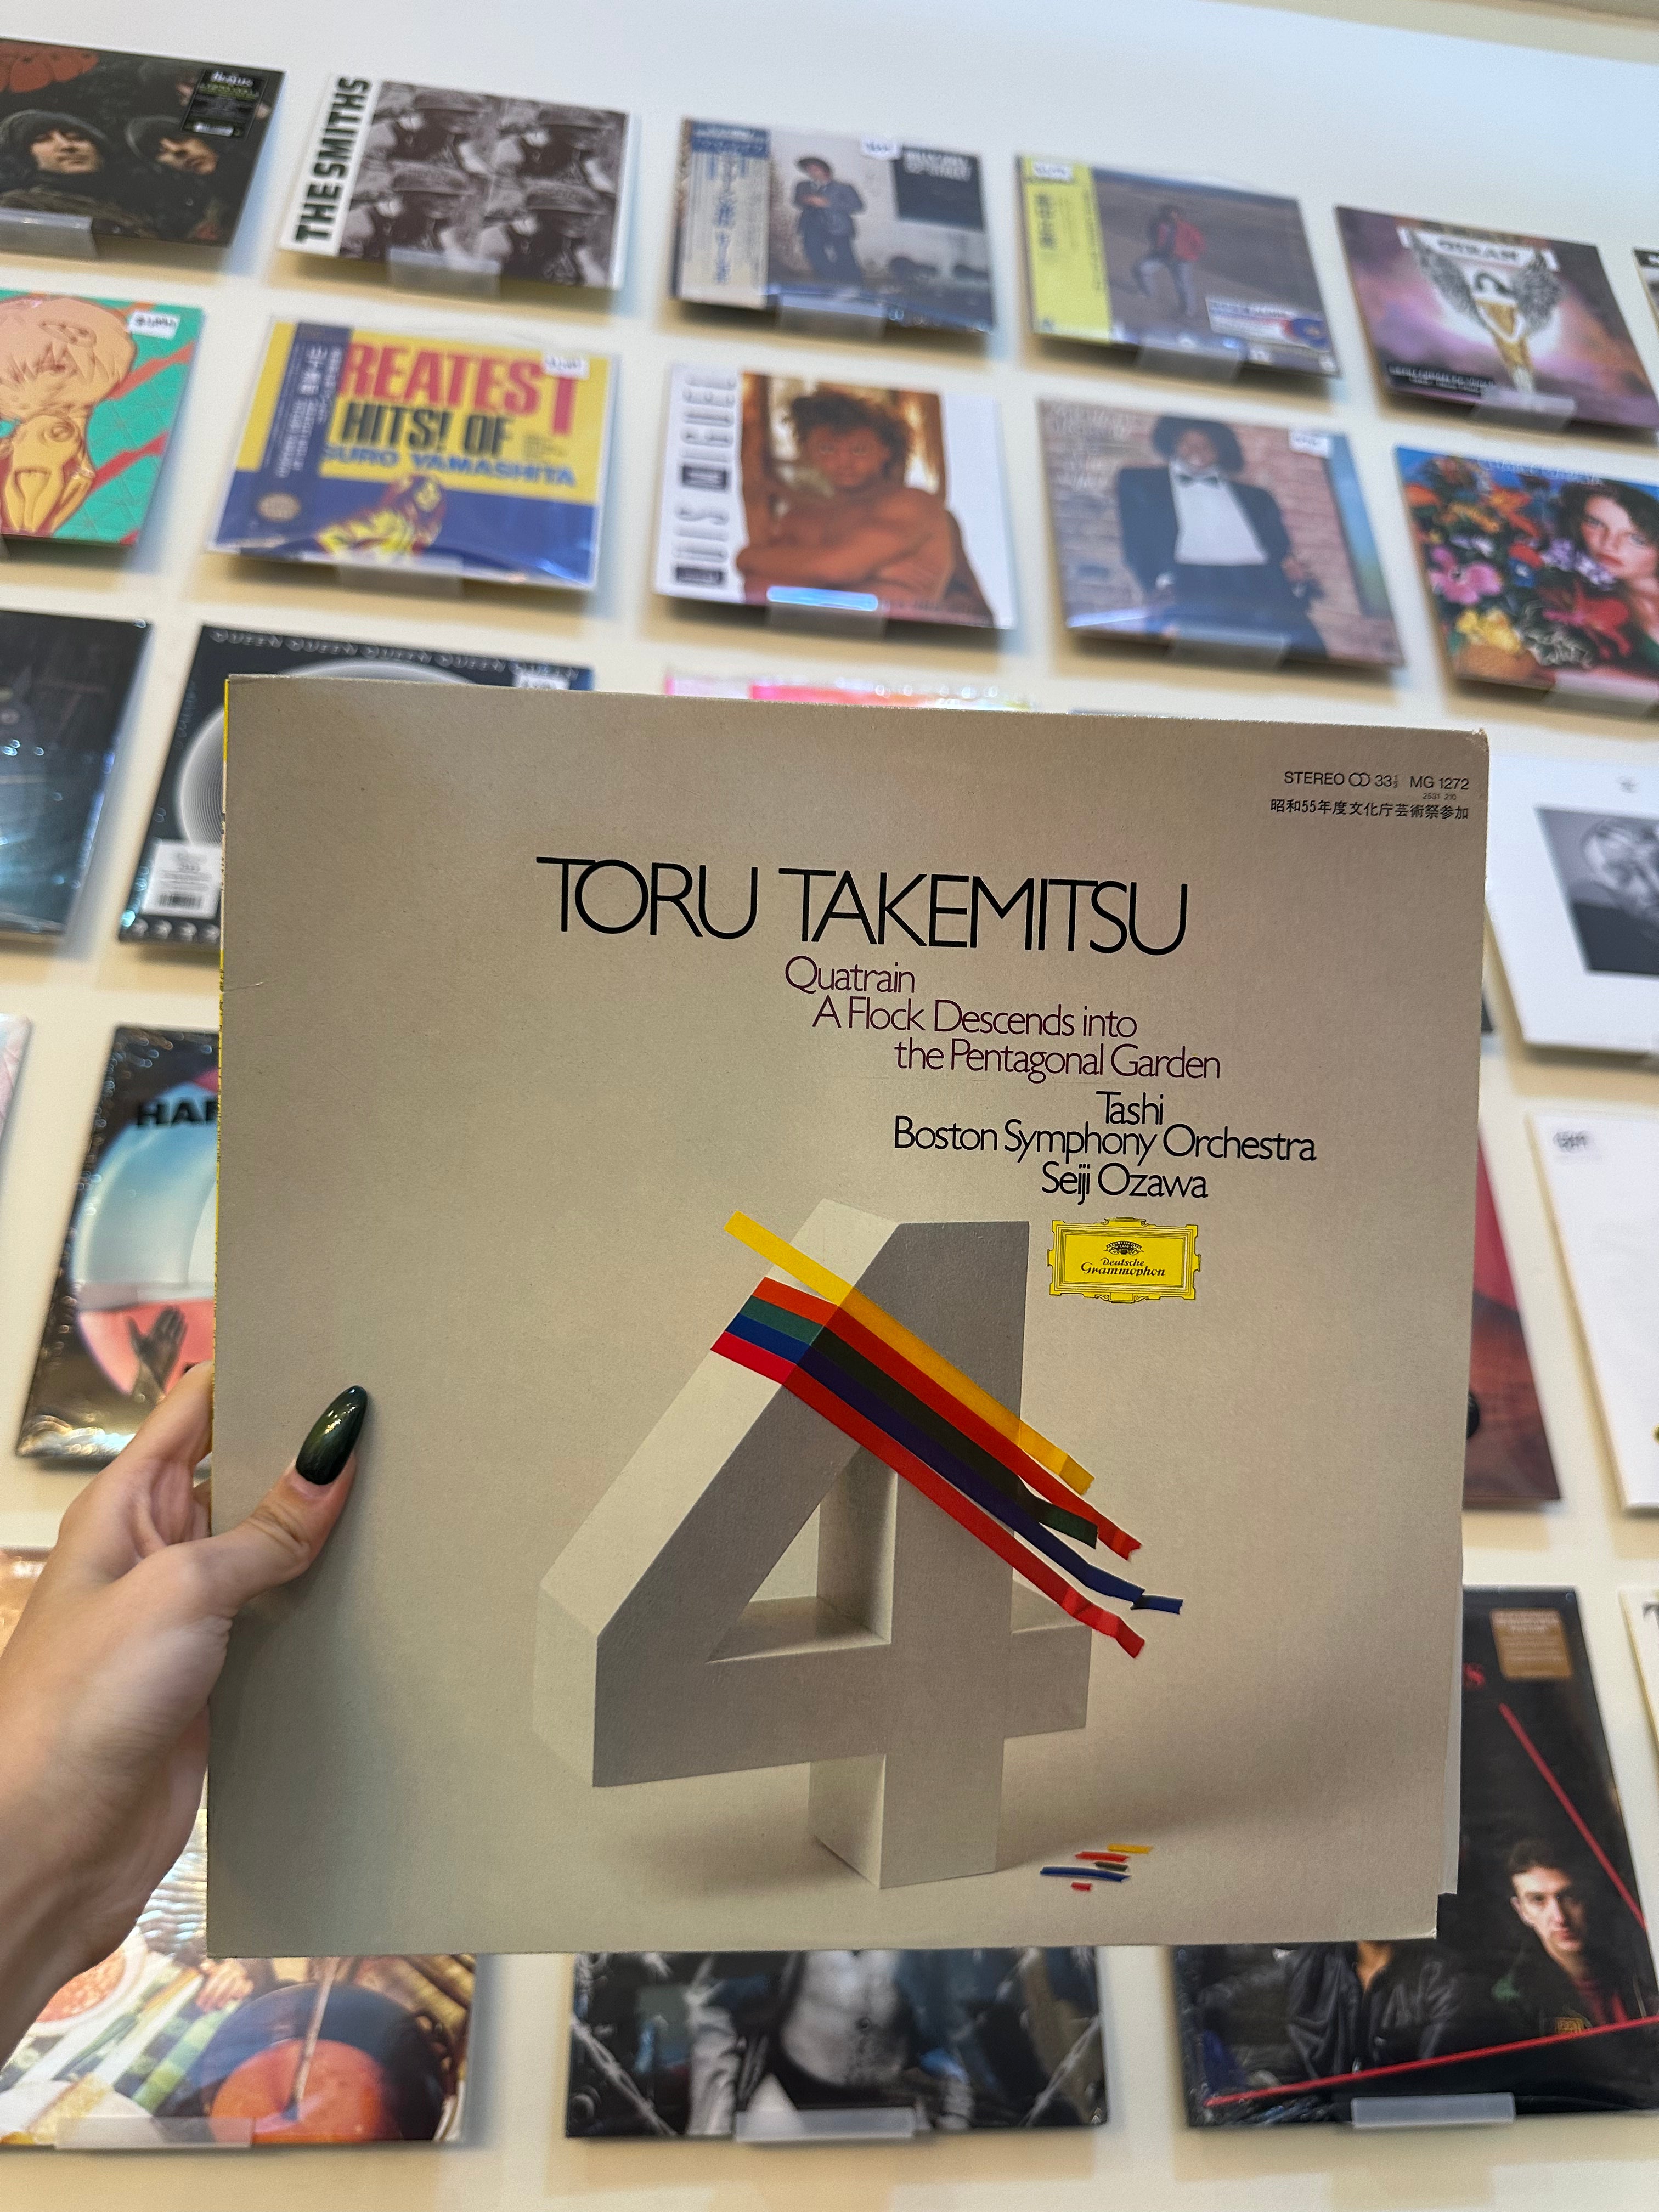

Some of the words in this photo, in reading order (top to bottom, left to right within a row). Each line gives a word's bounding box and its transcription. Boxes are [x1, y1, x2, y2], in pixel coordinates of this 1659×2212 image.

[313, 76, 370, 177] SMITHS
[295, 182, 342, 242] THE
[464, 414, 514, 460] OF
[1284, 770, 1345, 786] STEREO
[1409, 776, 1434, 789] MG
[1438, 776, 1470, 791] 1272
[1270, 798, 1469, 820] 昭和55年度文化庁芸術祭参加
[536, 856, 758, 940] TORU
[778, 868, 1188, 956] TAKEMITSU
[785, 955, 916, 995] Quatrain
[812, 995, 842, 1028] A
[849, 996, 926, 1031] Flock
[934, 999, 1075, 1037] Descends
[1082, 1006, 1138, 1039] into
[894, 1036, 944, 1070] the
[951, 1038, 1104, 1084] Pentagonal
[1110, 1043, 1221, 1079] Garden
[1096, 1090, 1164, 1126] Tashi
[894, 1115, 997, 1152] Boston
[1003, 1119, 1158, 1166] Symphony
[1163, 1123, 1317, 1161] Orchestra
[1041, 1161, 1091, 1205] Seiji
[1098, 1162, 1209, 1199] Ozawa
[1081, 1262, 1165, 1277] Grammophon
[1100, 1257, 1145, 1267] Deutsche
